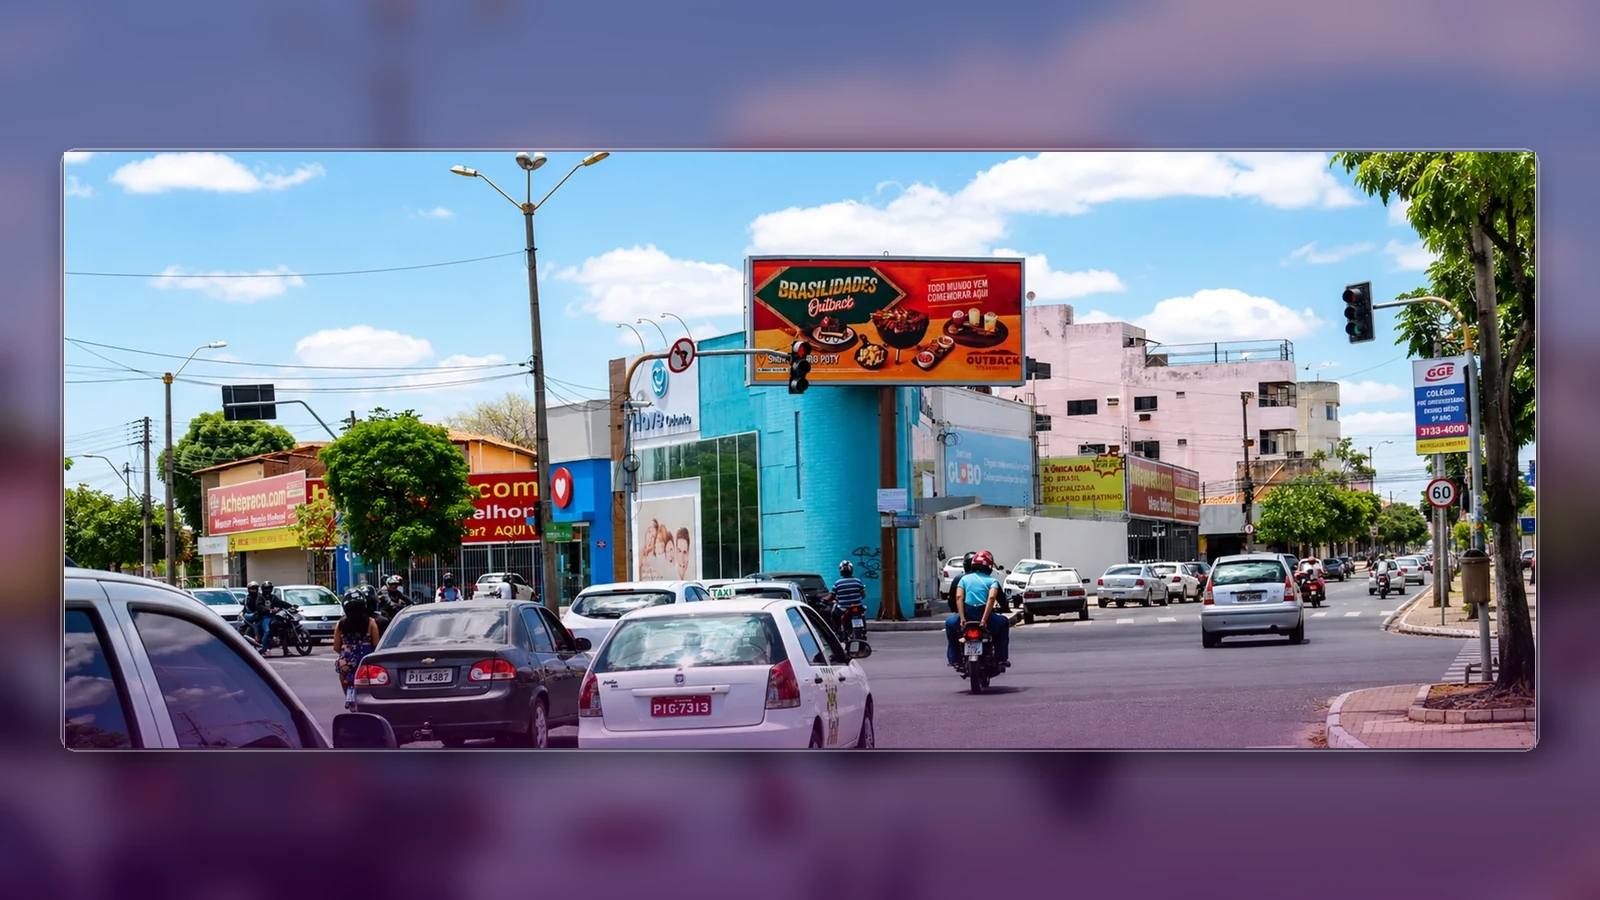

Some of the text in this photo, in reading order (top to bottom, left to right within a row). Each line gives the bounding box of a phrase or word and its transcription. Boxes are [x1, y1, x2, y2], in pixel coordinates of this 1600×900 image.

[778, 276, 878, 299] BRASILIDADES
[928, 279, 989, 293] TODO MUNDO VEM
[928, 289, 989, 302] COMEMORAR AQUI
[808, 295, 854, 317] Outback
[820, 354, 840, 365] POTY
[966, 356, 1020, 366] OUTBACK
[1427, 366, 1454, 378] GGE
[1426, 388, 1455, 398] COLÉGIO
[1420, 424, 1465, 436] 3133-4000
[948, 461, 981, 485] GLOBO
[1050, 464, 1073, 474] ÚNICA
[1074, 464, 1092, 473] LOJA
[478, 480, 539, 499] com
[1432, 486, 1452, 500] 60
[472, 504, 536, 520] elhor
[494, 524, 527, 537] AQUI
[711, 588, 733, 597] TAXI
[408, 672, 451, 683] PIL-4387
[653, 702, 709, 715] PIG-7313
